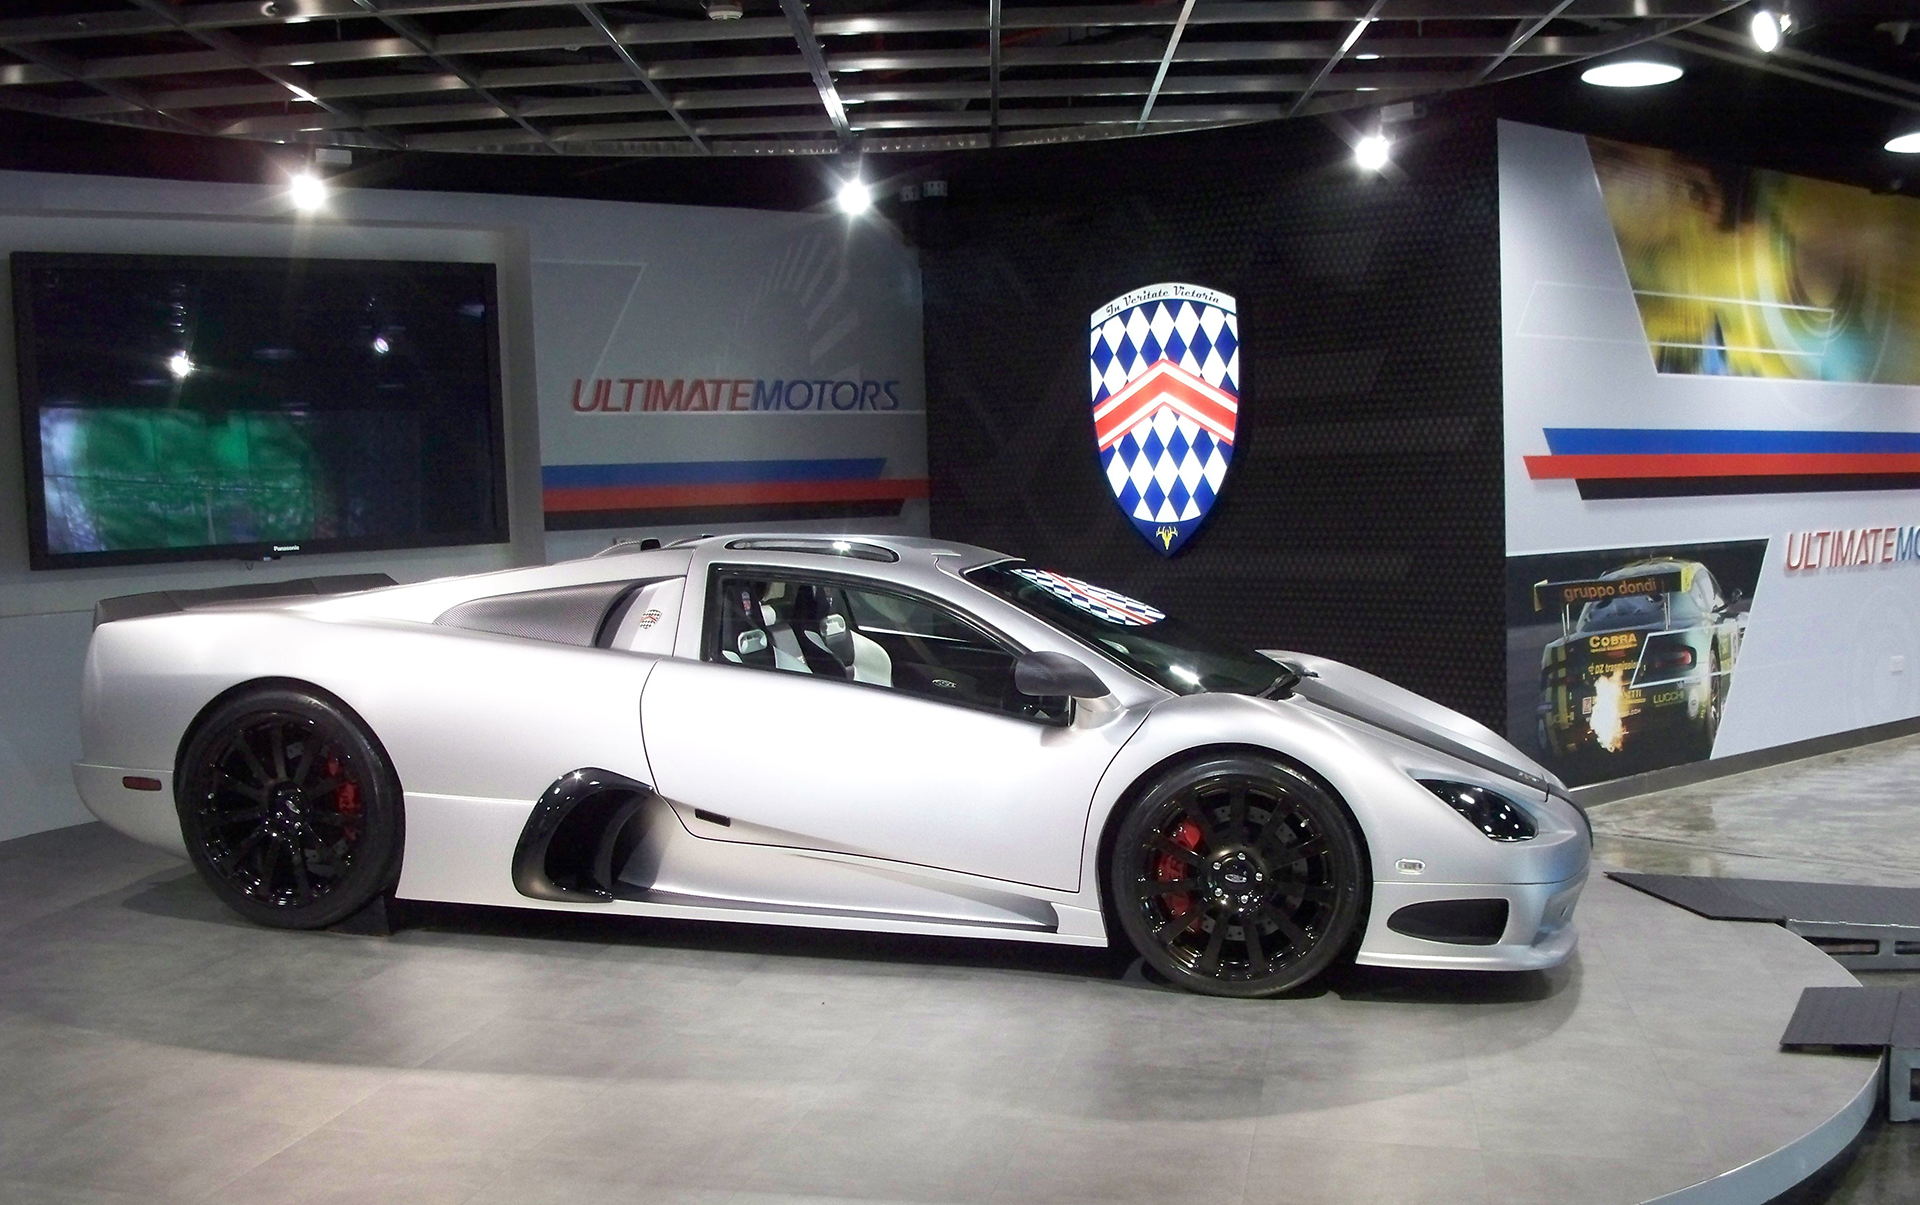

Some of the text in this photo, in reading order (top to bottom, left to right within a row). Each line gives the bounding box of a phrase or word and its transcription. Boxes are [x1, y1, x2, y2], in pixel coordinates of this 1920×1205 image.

[1106, 285, 1219, 316] In Veritate Victoria
[1563, 578, 1657, 602] gruppo dondi
[1589, 633, 1637, 648] COBRA
